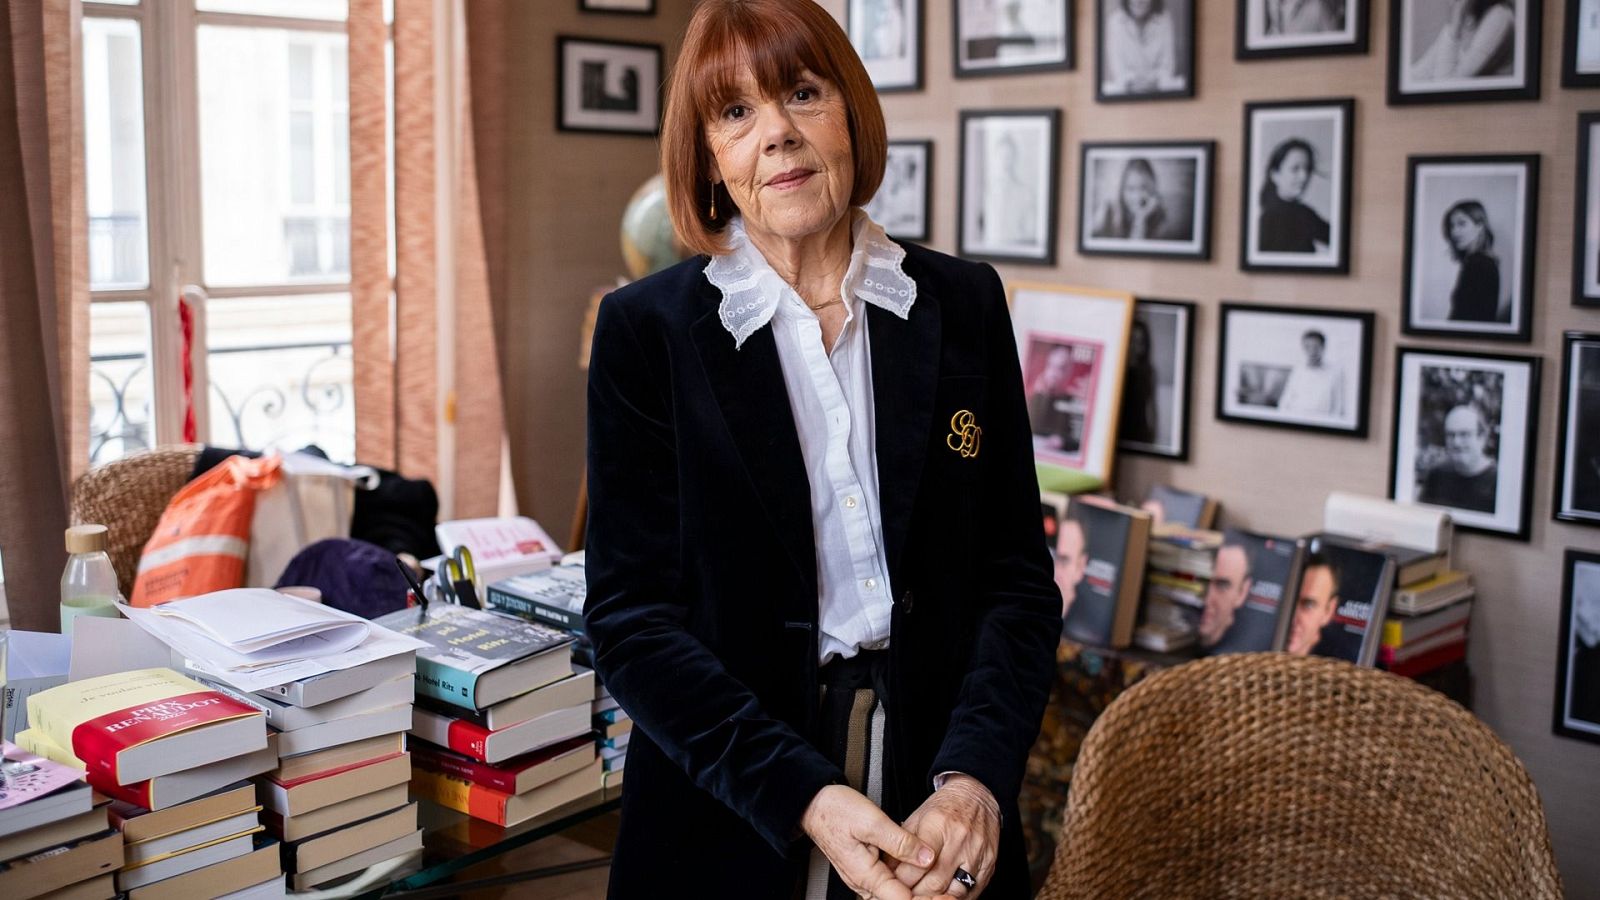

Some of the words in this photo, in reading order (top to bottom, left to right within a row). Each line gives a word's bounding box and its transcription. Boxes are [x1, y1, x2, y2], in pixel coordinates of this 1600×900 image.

[442, 681, 455, 692] Ritz
[105, 697, 221, 733] RENAUDOT
[131, 700, 183, 717] PRIX
